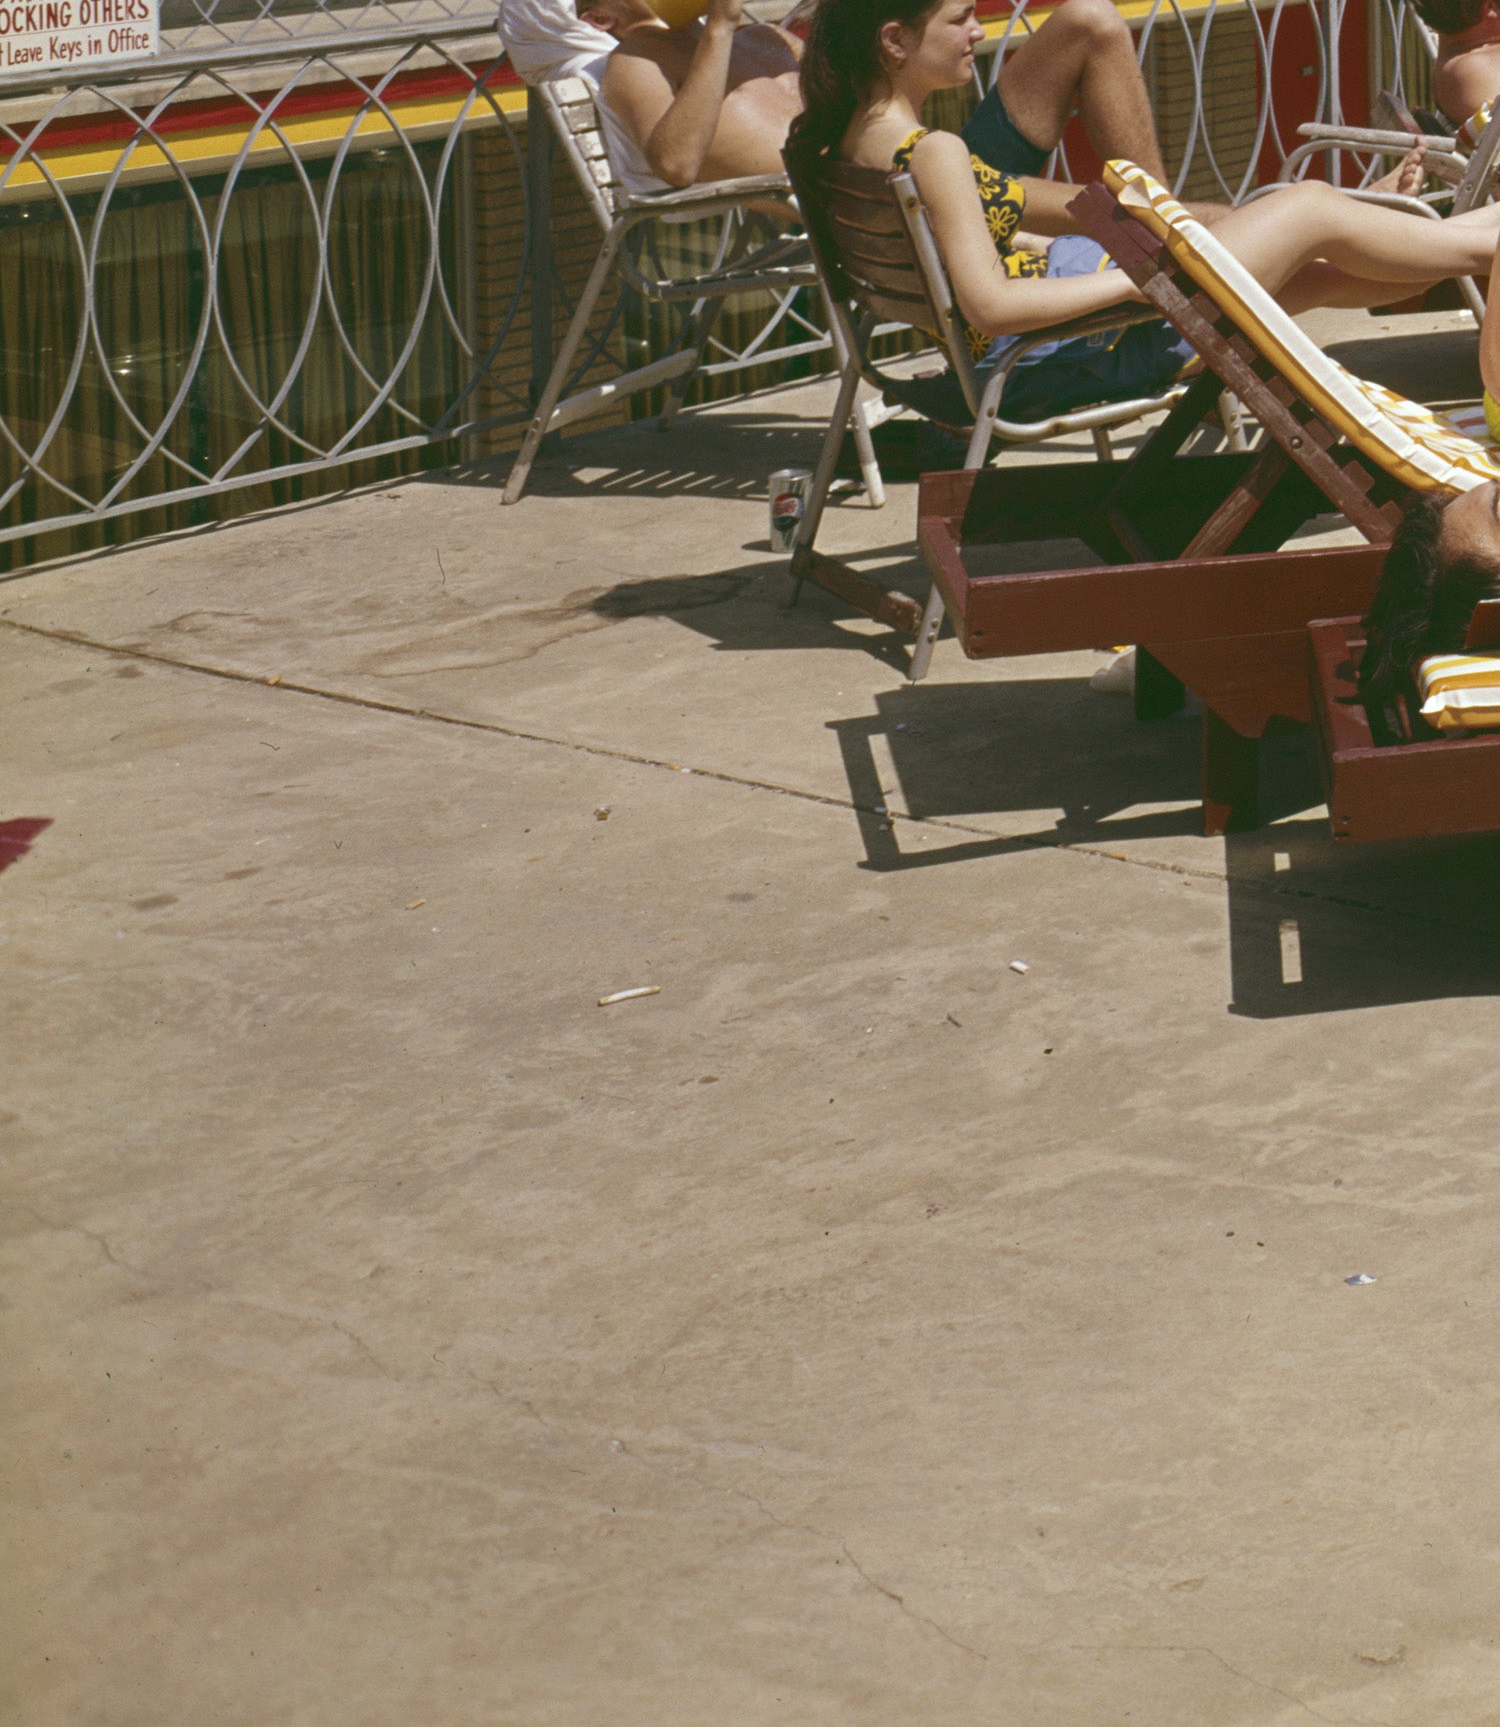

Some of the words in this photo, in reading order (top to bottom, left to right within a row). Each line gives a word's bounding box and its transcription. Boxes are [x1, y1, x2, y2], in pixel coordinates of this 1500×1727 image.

[7, 41, 43, 66] Leave
[49, 35, 83, 62] Keys
[88, 35, 102, 55] in
[108, 27, 149, 53] Office
